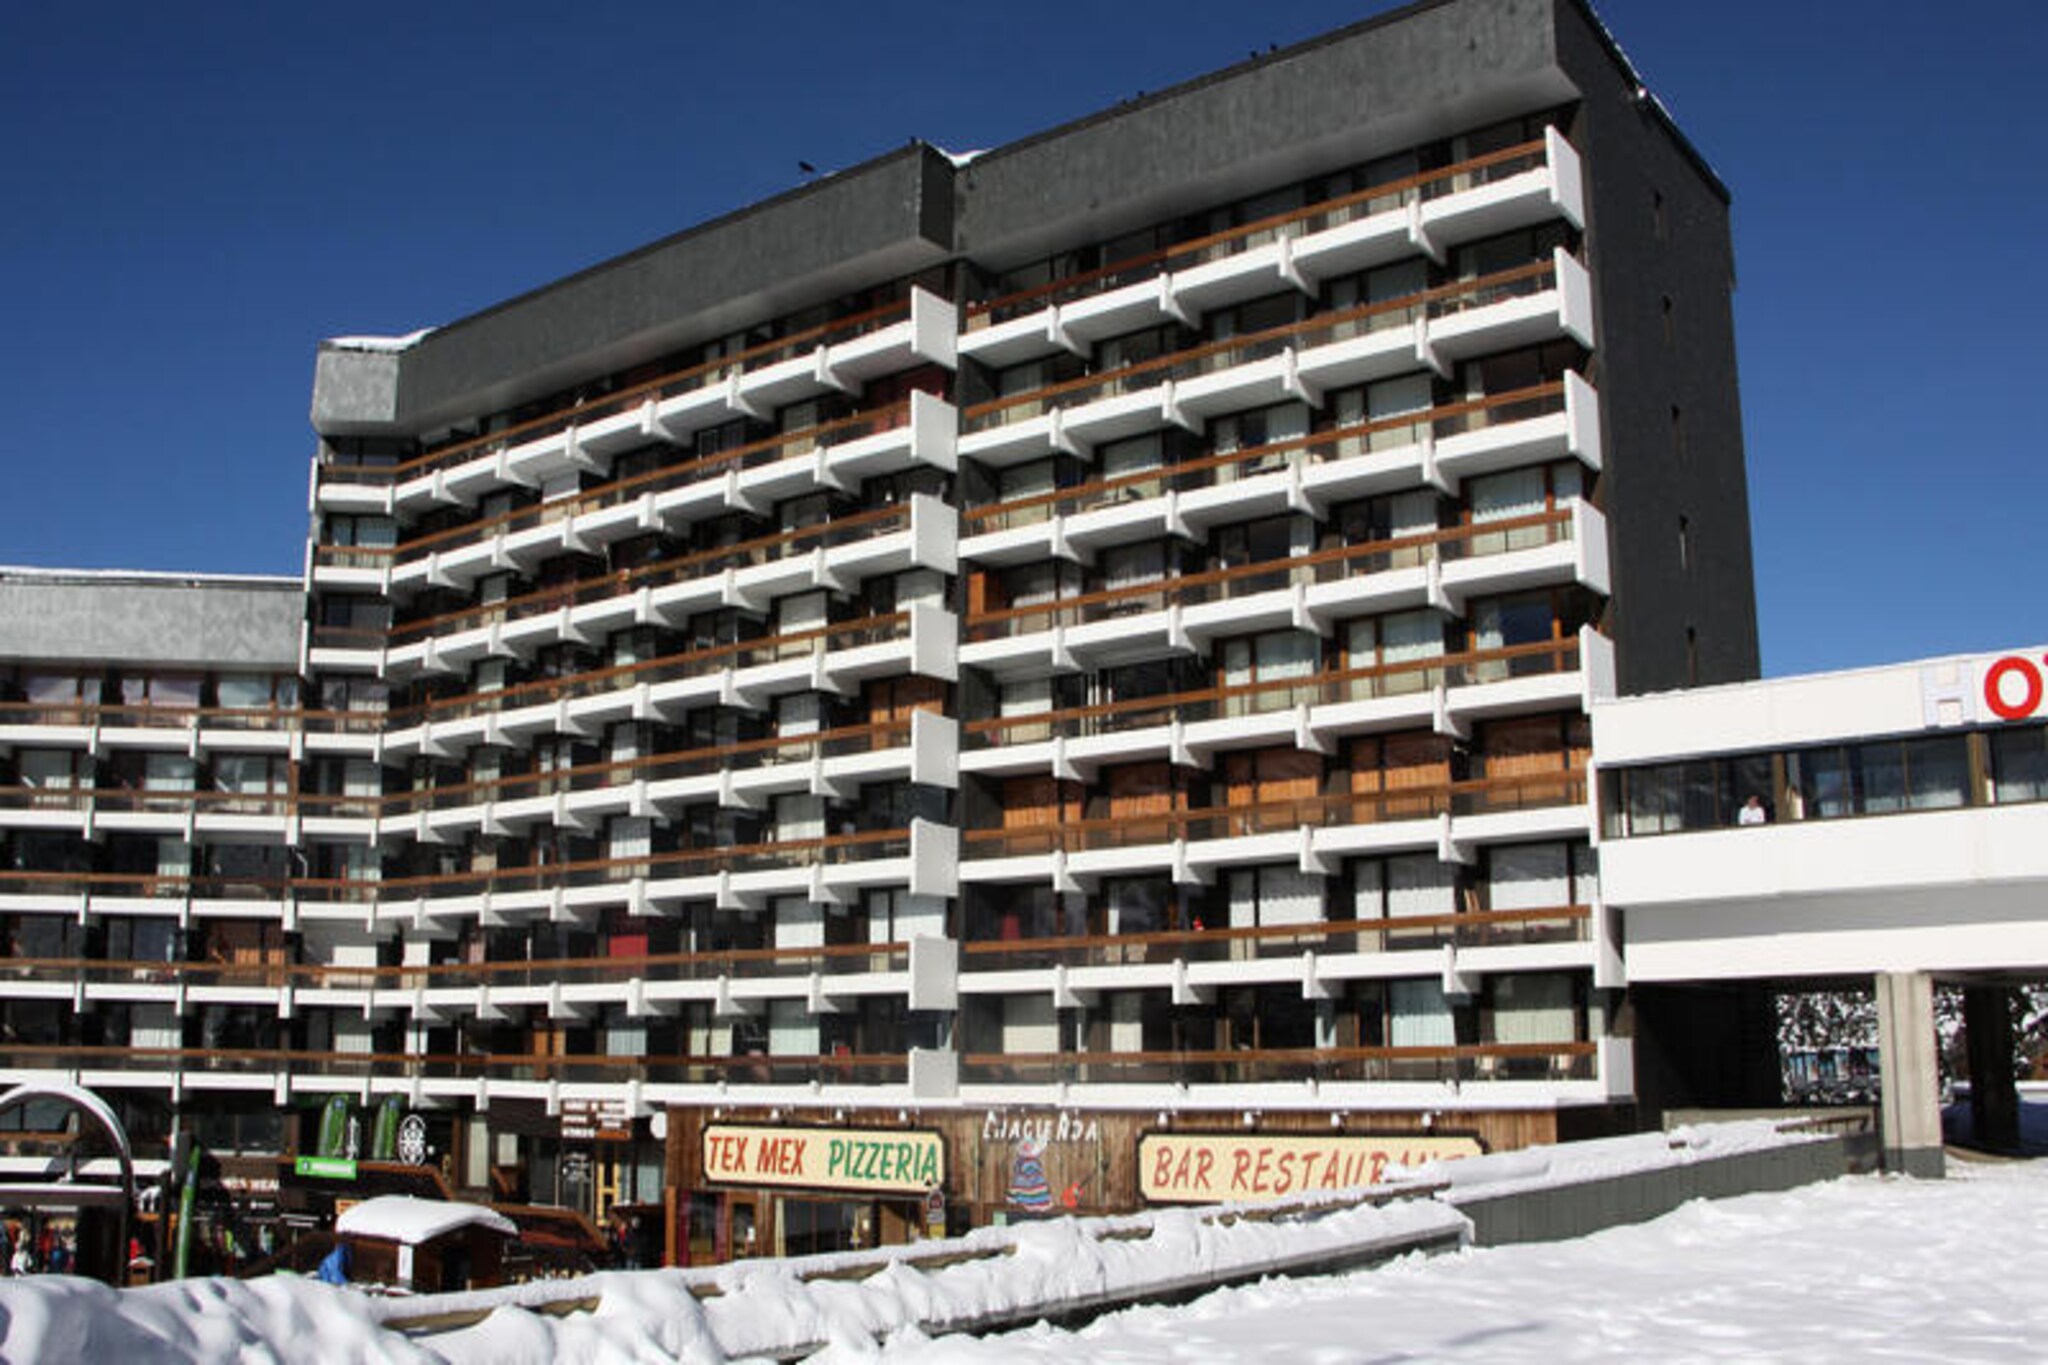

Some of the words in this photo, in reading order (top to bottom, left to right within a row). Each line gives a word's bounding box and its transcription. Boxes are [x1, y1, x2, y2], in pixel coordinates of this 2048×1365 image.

[709, 1136, 748, 1172] TEX
[757, 1137, 807, 1176] MEX
[828, 1139, 938, 1184] PIZZERIA
[1153, 1146, 1214, 1190] BAR
